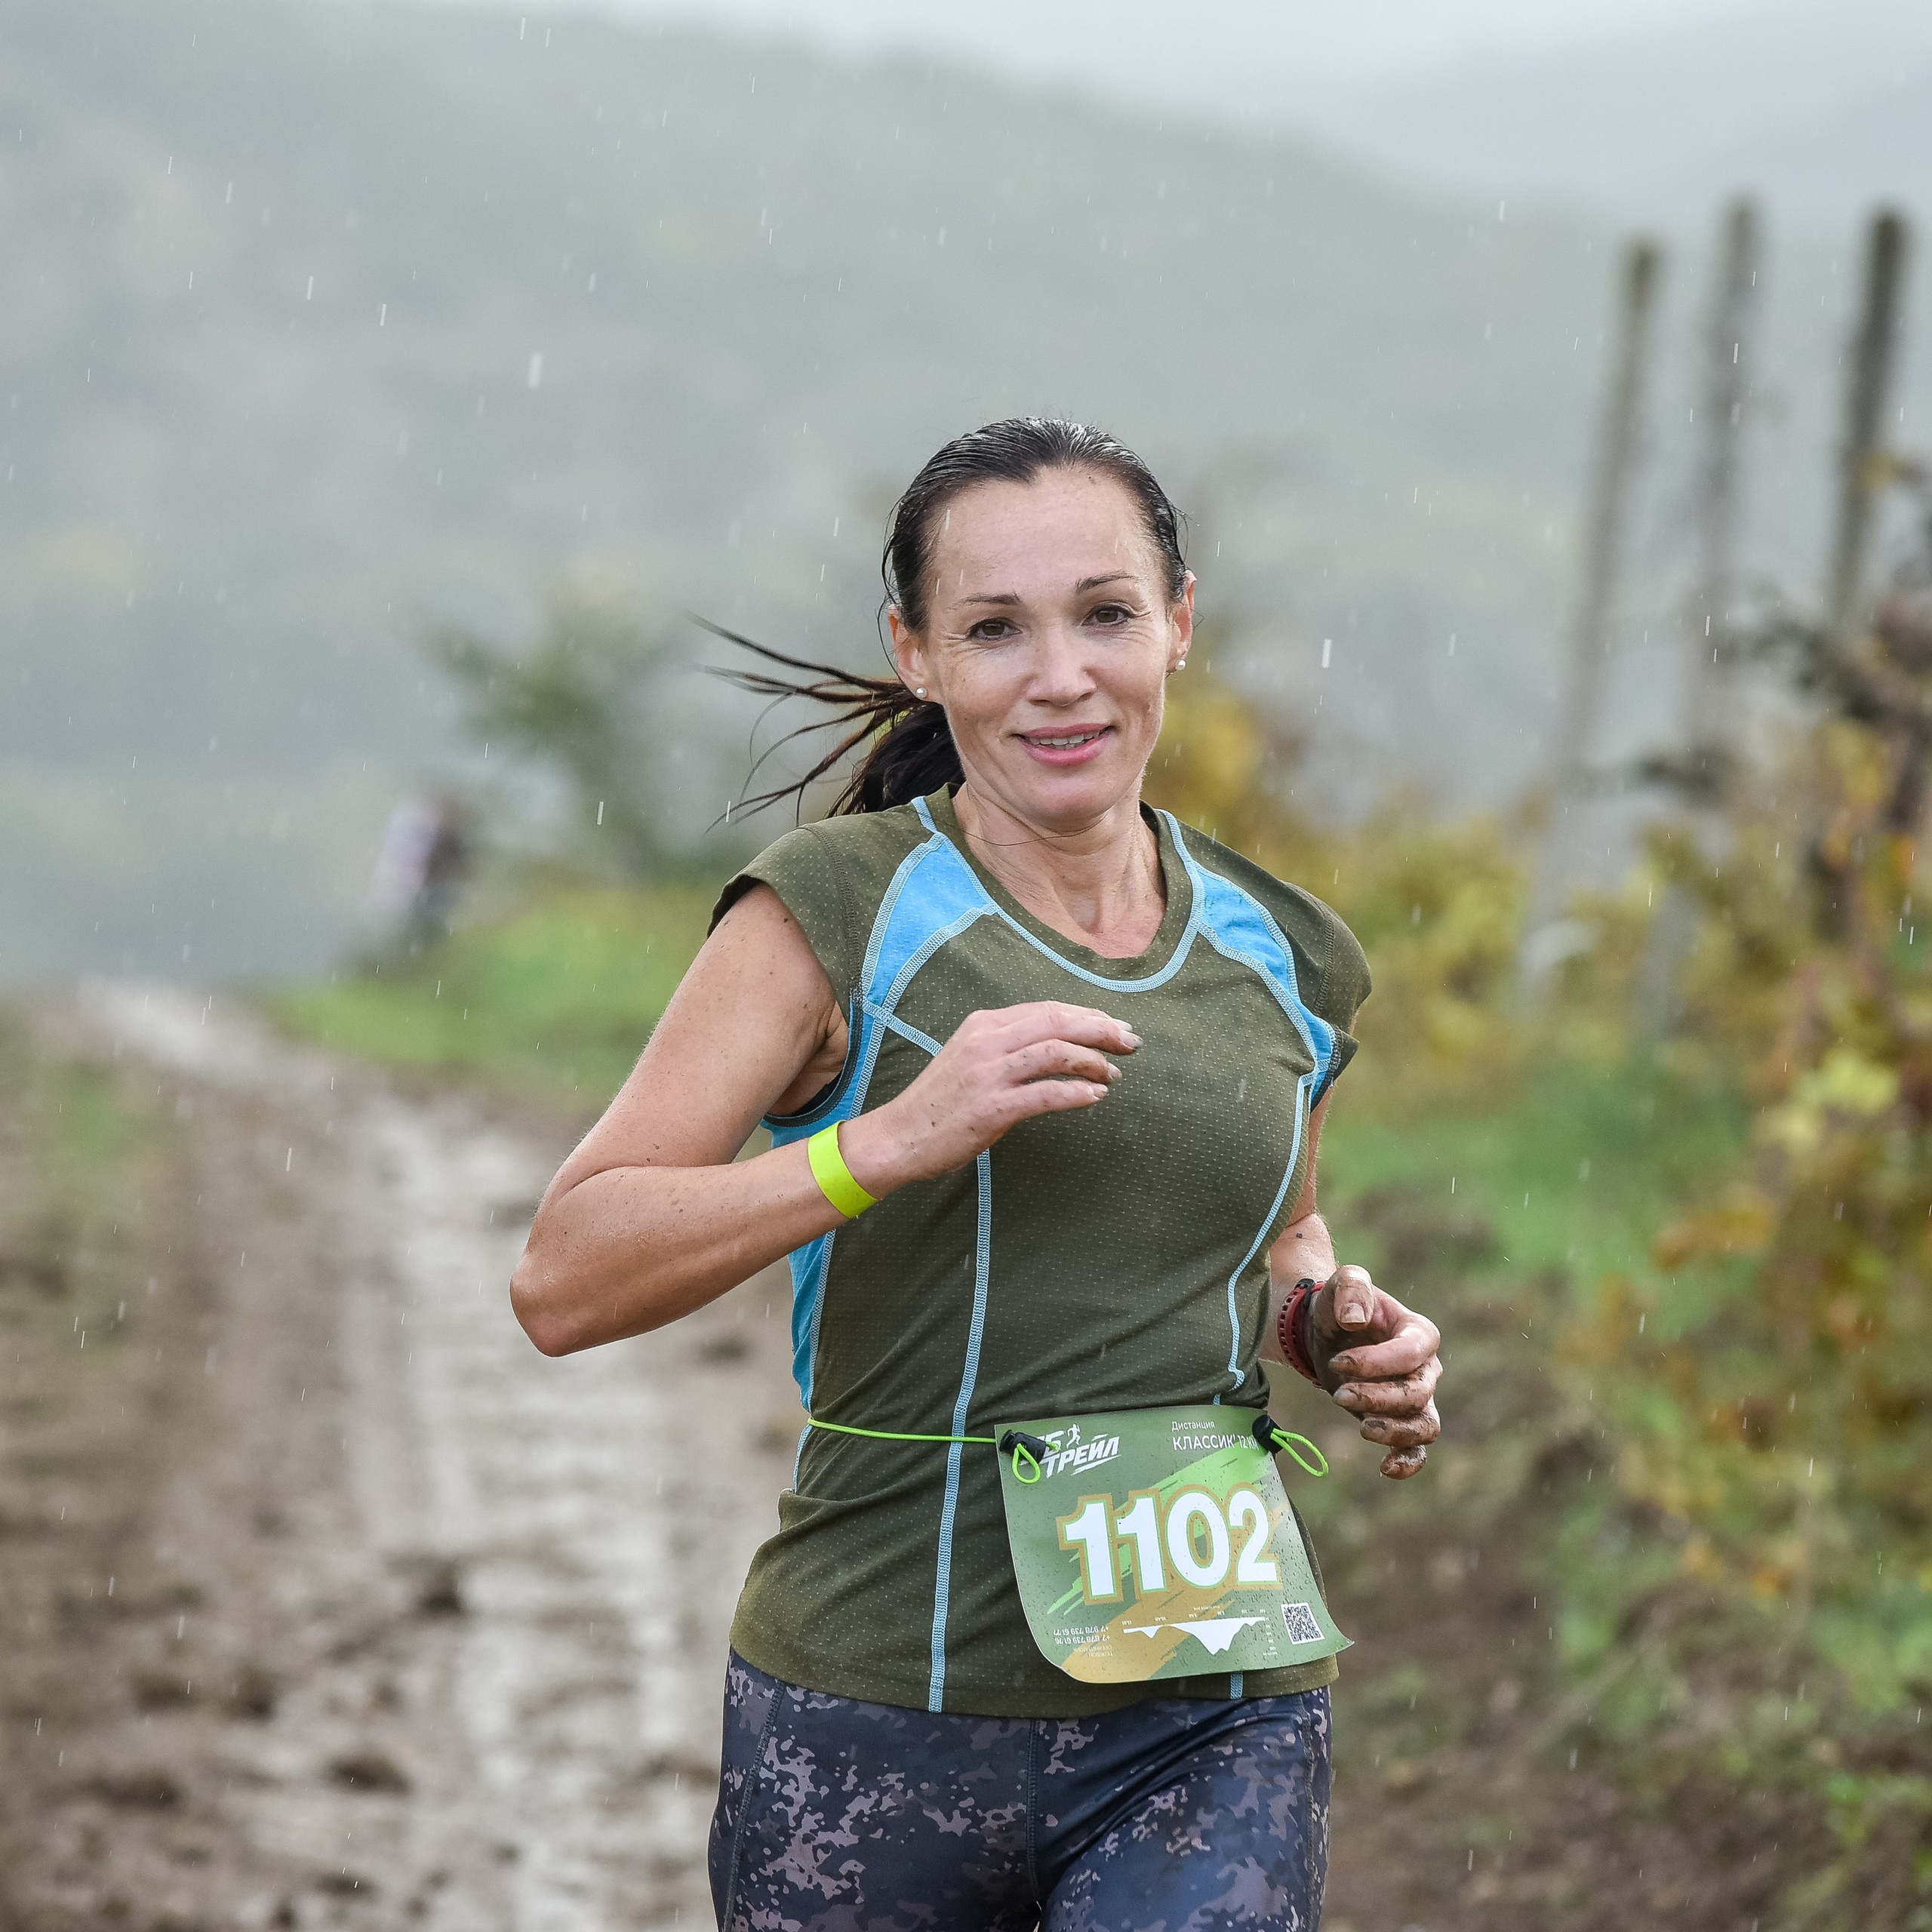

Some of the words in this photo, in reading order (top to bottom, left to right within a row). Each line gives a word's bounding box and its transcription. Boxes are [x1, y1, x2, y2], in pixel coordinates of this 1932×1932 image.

[1171, 1421, 1215, 1432] Дистанция
[1039, 1434, 1120, 1478] ТРЕЙЛ
[1065, 1491, 1278, 1597] 1102
